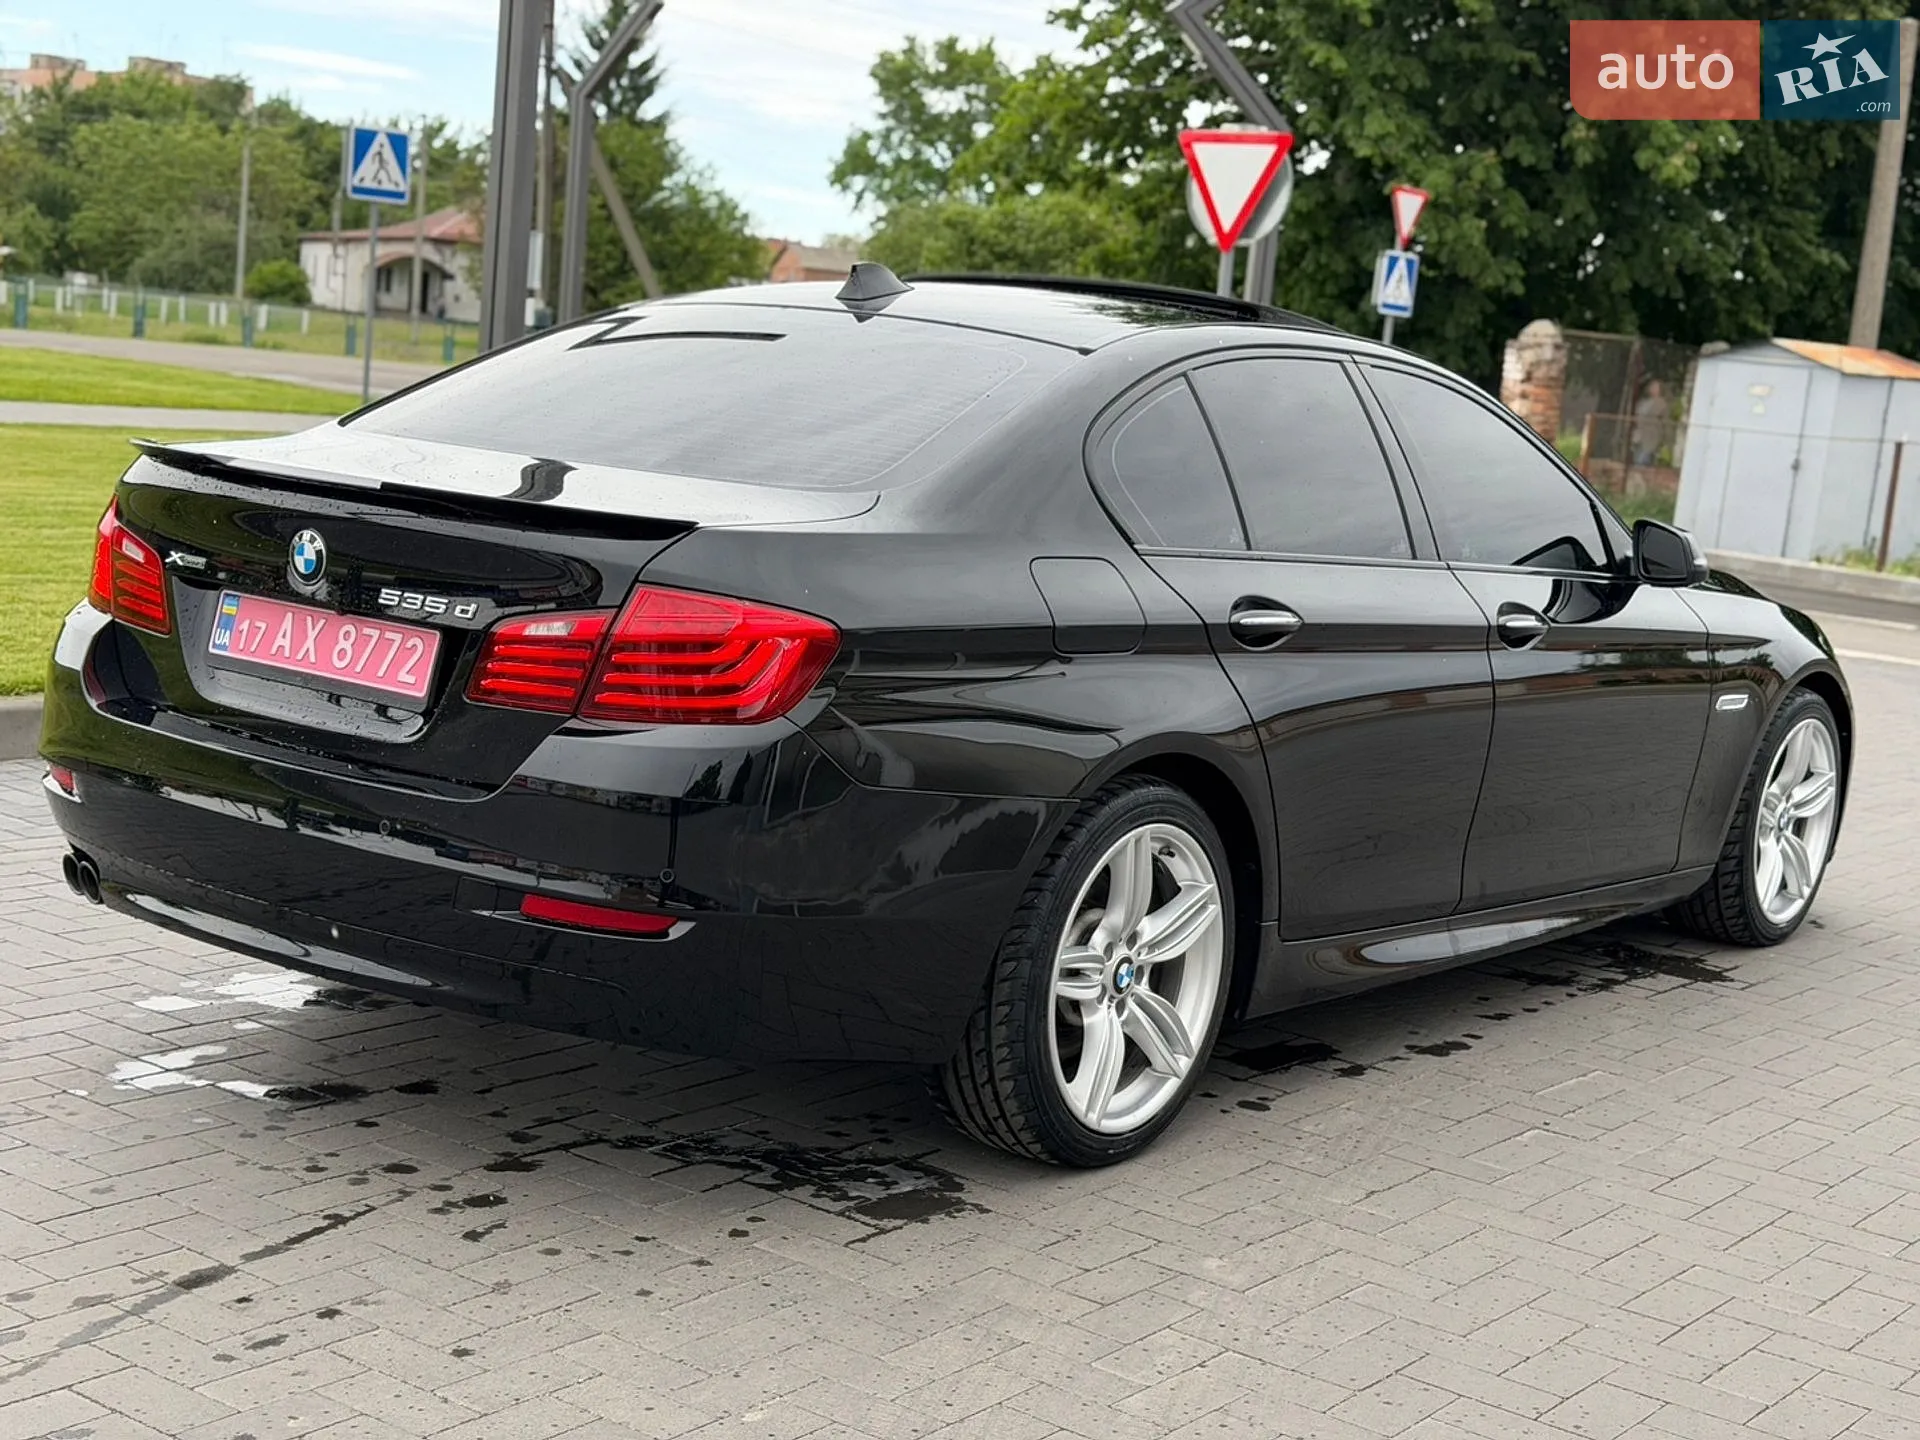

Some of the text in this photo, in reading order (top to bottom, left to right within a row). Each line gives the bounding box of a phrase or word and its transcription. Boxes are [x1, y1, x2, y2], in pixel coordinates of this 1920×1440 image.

[378, 588, 478, 619] 535 d
[214, 628, 230, 646] UA
[238, 611, 425, 684] 17 AX 8772
